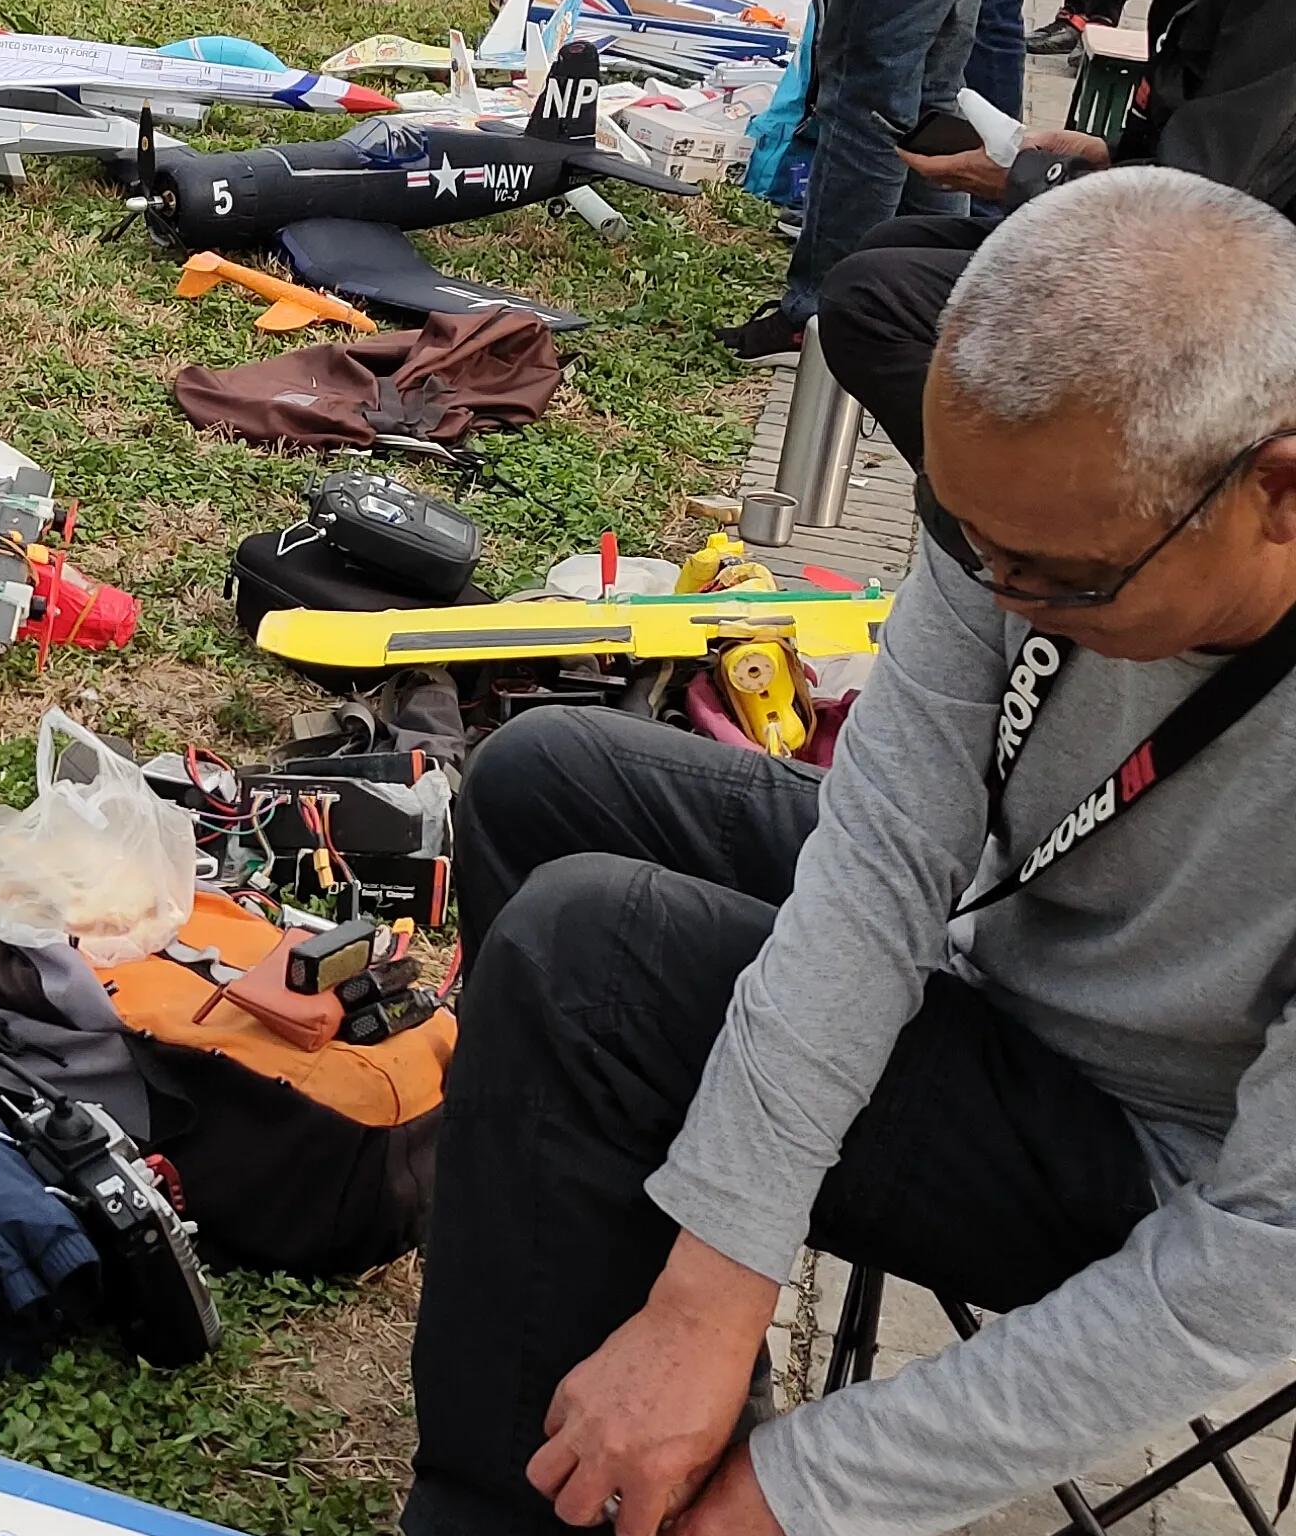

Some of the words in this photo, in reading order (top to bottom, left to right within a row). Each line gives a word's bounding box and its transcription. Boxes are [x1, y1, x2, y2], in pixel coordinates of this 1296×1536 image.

[22, 43, 53, 54] STATES
[54, 47, 69, 55] AIR
[70, 49, 100, 59] FORCE
[542, 78, 600, 119] NP
[483, 164, 534, 190] NAVY
[212, 179, 233, 215] 5
[494, 189, 519, 202] VC-3
[997, 636, 1060, 781] PROPO
[1019, 777, 1116, 883] PROPO
